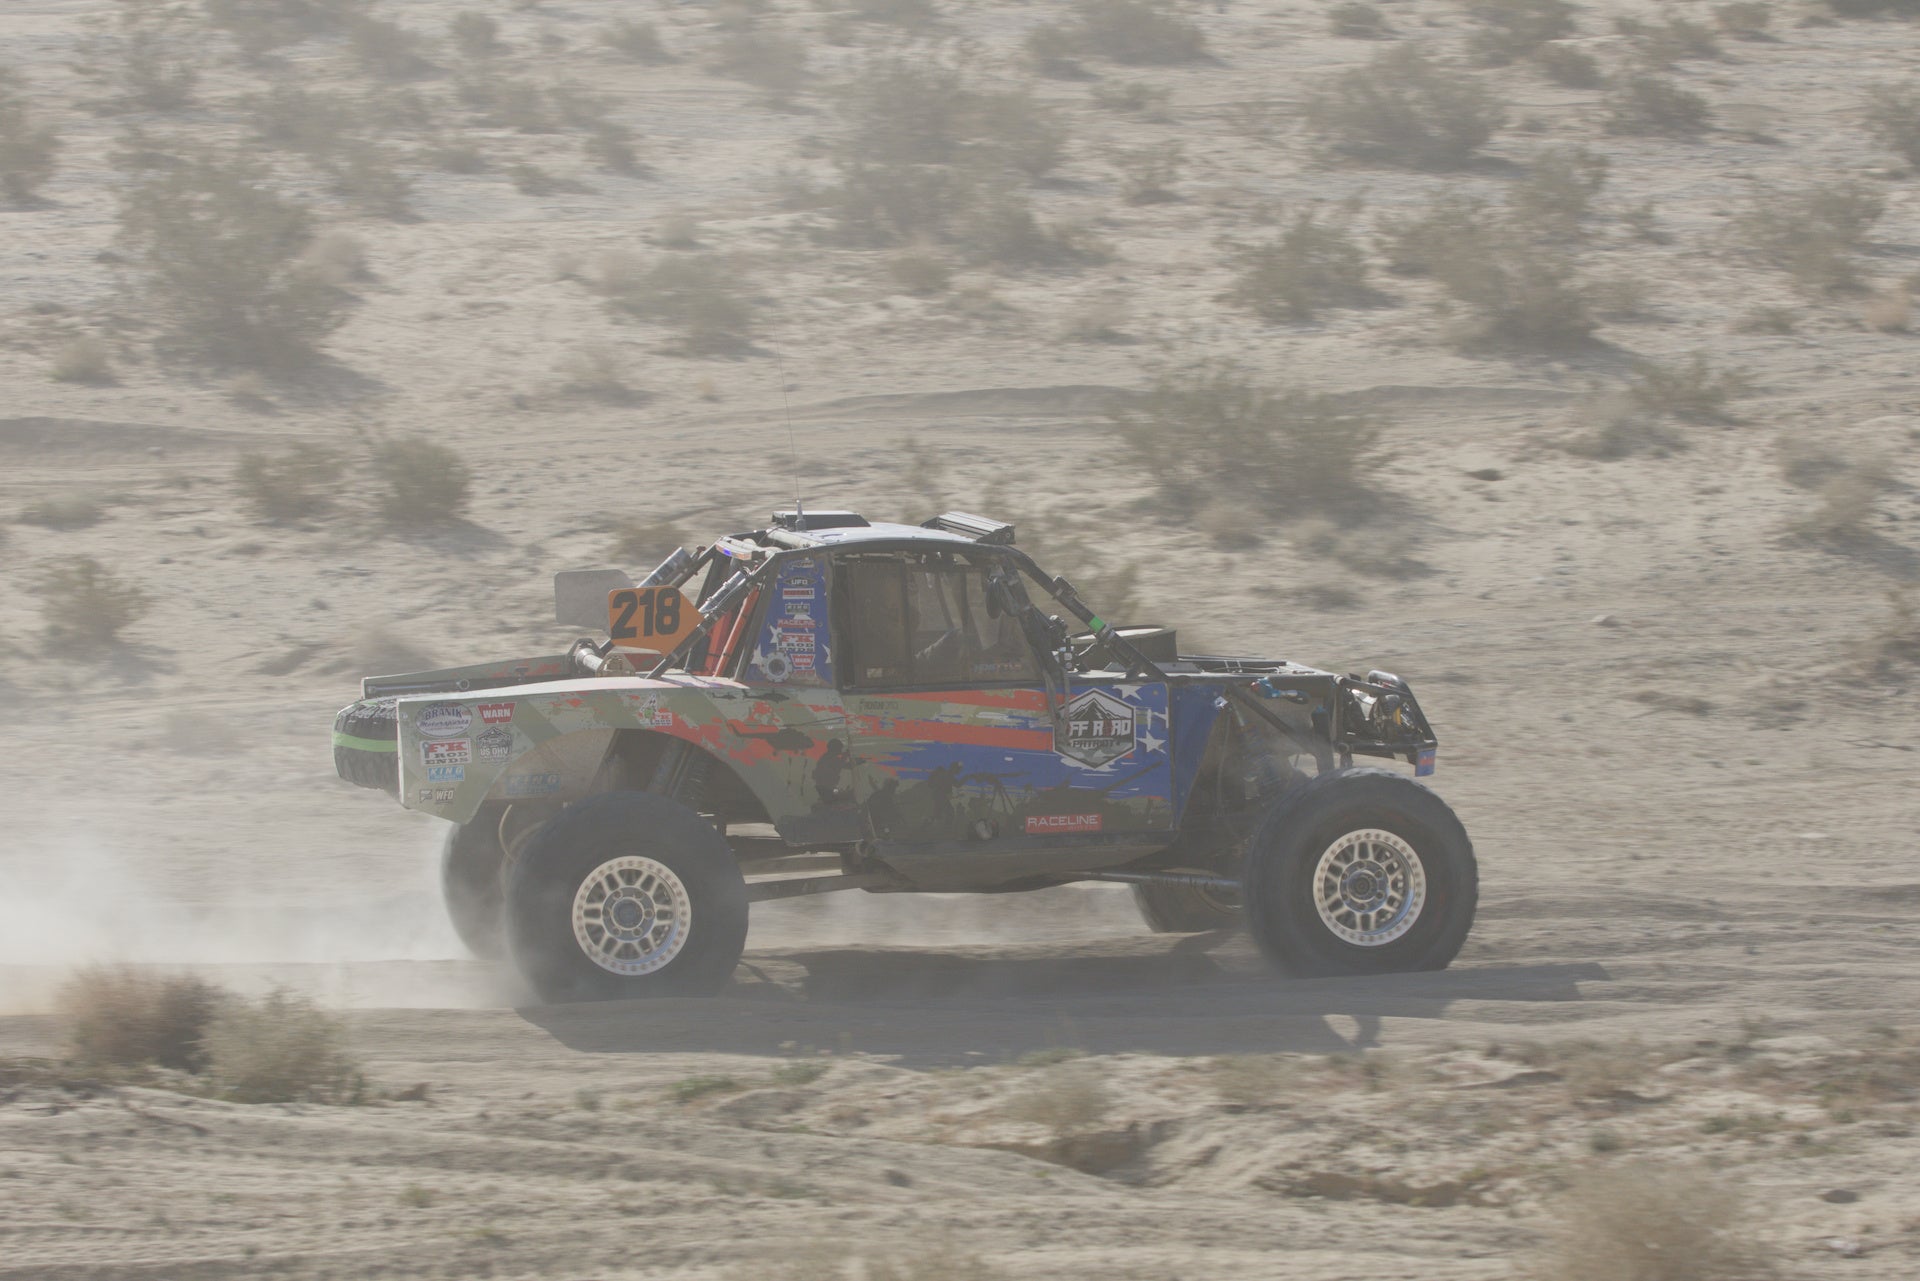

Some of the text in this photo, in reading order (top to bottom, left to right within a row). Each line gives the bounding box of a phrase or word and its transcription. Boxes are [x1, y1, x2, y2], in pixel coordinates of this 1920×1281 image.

[611, 588, 681, 640] 218
[782, 634, 813, 642] FK
[425, 707, 463, 721] BRANIK
[483, 709, 511, 718] WARN
[430, 742, 467, 752] FK
[430, 767, 464, 775] KING
[1027, 814, 1098, 828] RACELINE
